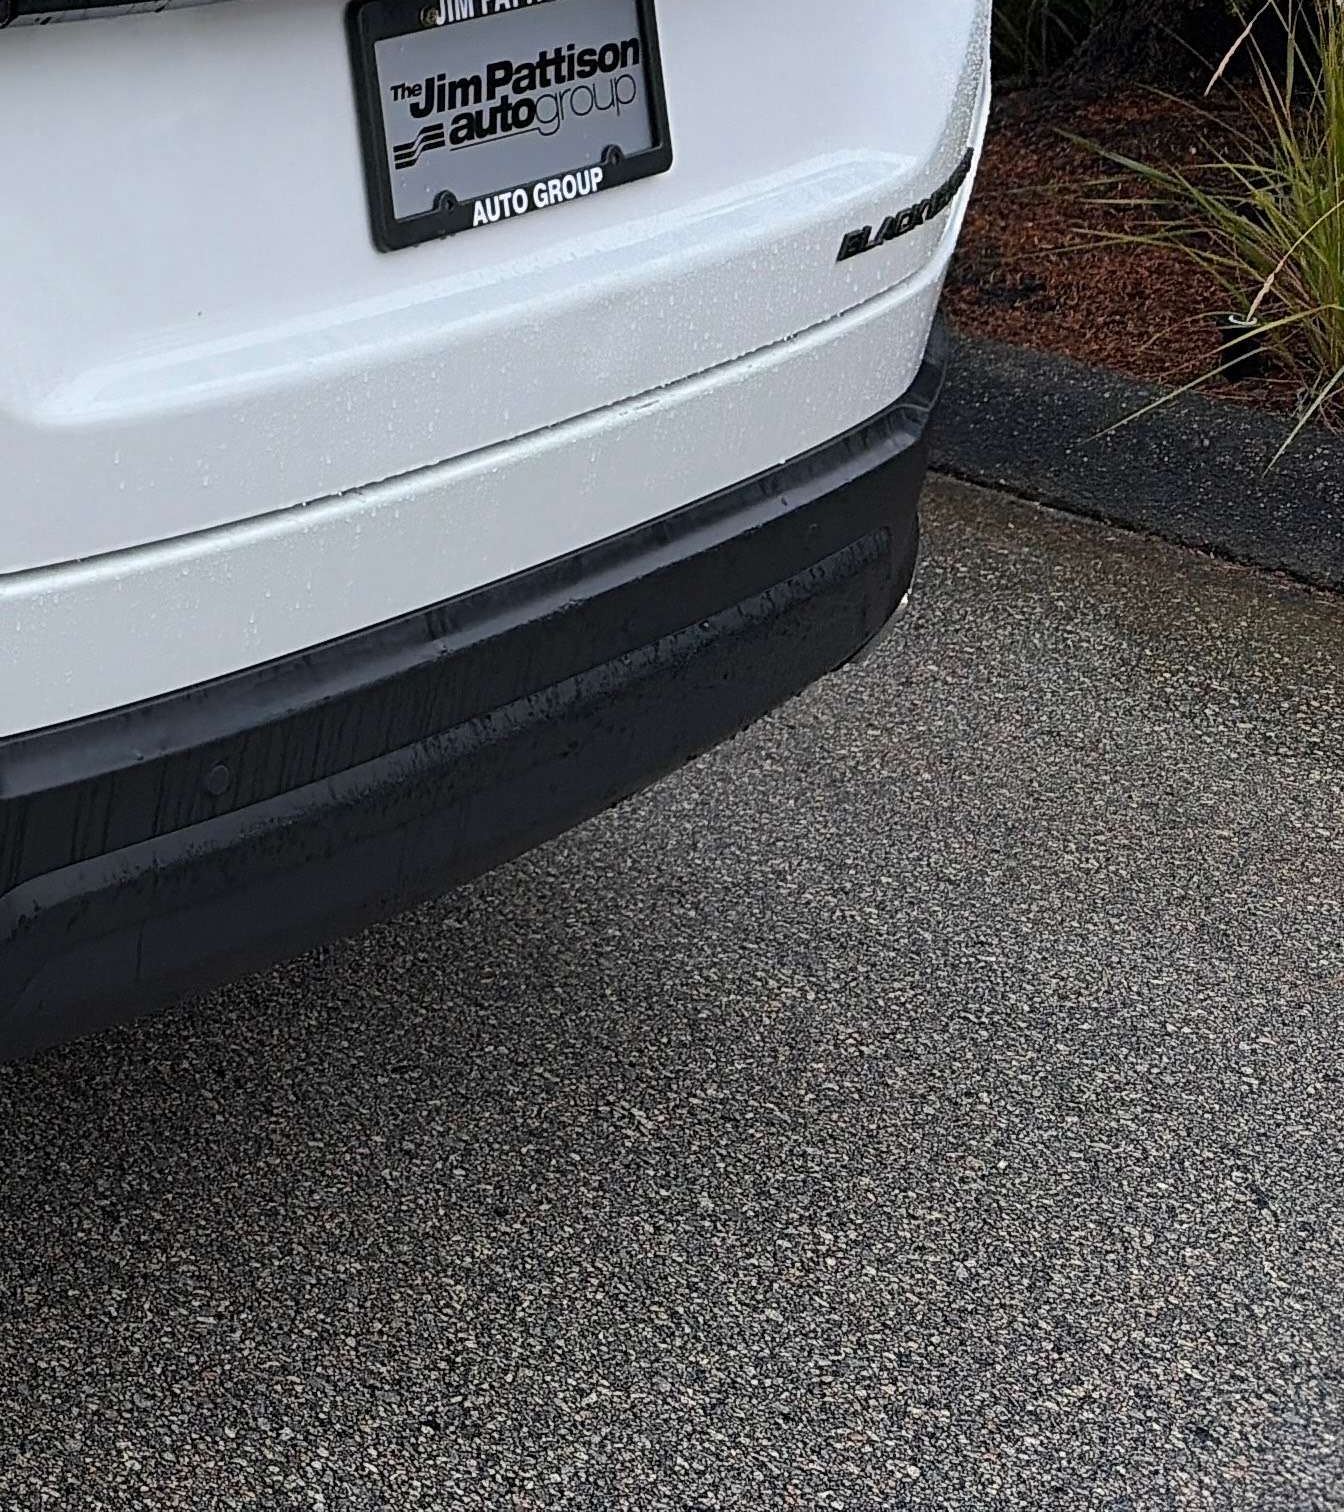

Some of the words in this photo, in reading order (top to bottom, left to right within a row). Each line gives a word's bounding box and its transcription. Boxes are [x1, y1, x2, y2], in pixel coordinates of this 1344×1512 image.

[390, 81, 423, 102] The
[409, 73, 483, 119] Jim
[485, 37, 641, 100] Pattison
[472, 187, 529, 227] AUTO
[532, 167, 604, 209] GROUP
